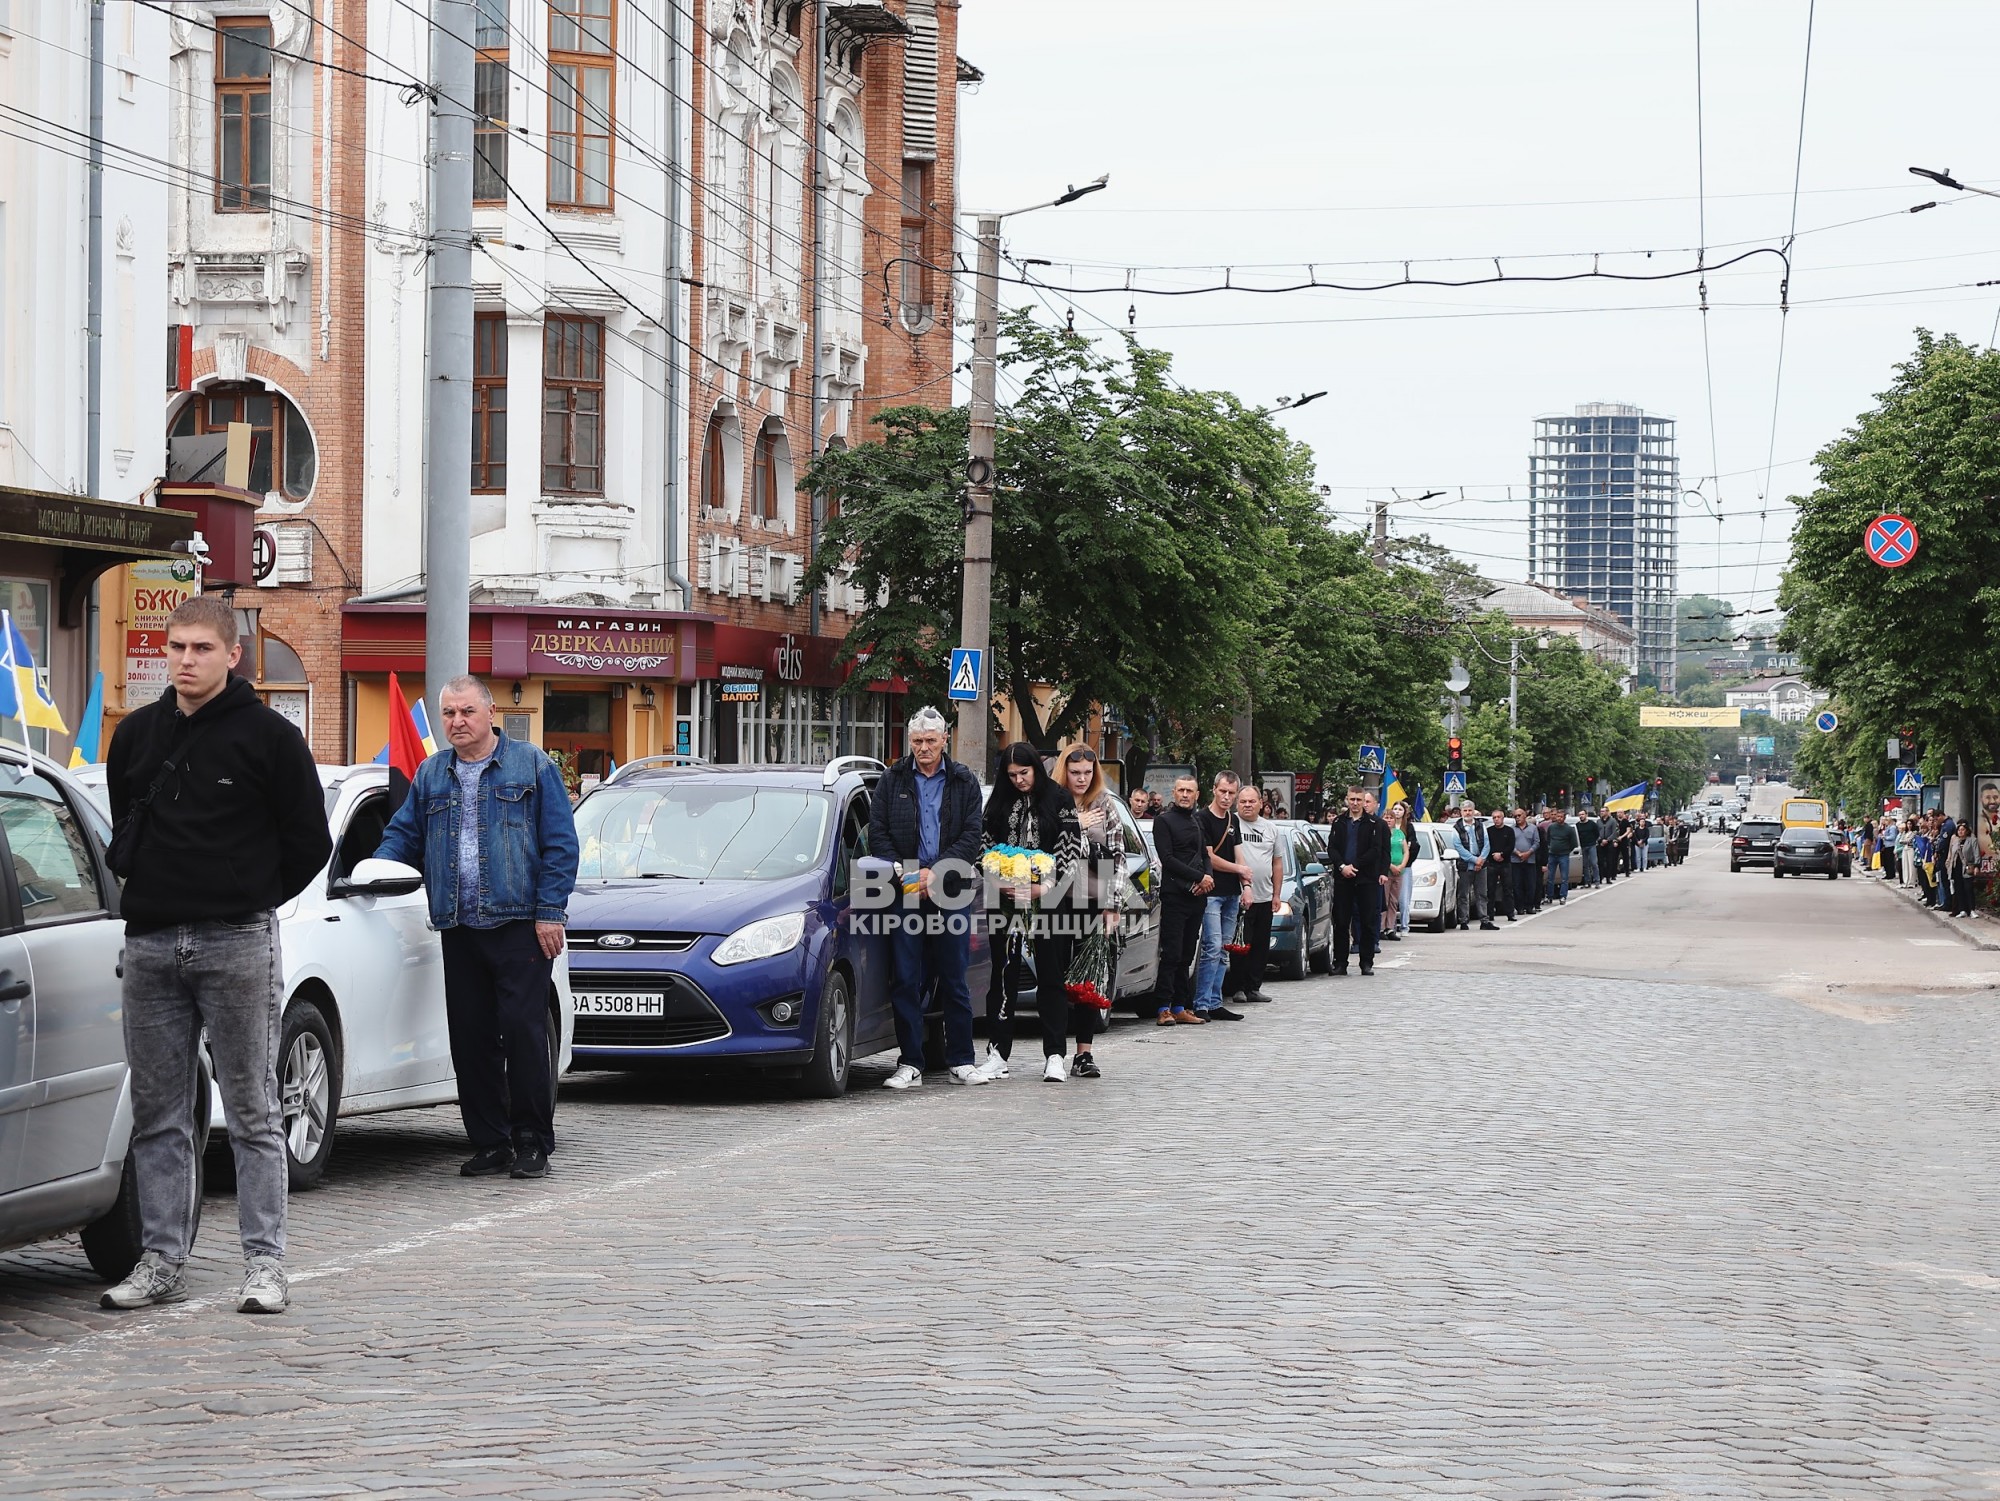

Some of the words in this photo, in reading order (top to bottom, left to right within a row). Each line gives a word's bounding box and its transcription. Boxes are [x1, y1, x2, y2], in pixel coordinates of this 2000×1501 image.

[38, 506, 80, 536] МОДНИЙ
[83, 512, 126, 540] ЖІНОЧИЙ
[557, 620, 661, 632] МАГАЗИН
[139, 633, 149, 646] 2
[530, 634, 675, 654] ДЗЕРКАЛЬНИЙ
[129, 647, 160, 656] поверх
[778, 633, 802, 680] elis
[136, 660, 167, 669] РЕМО
[723, 683, 758, 693] ОБМІН
[721, 693, 760, 702] ВАЛЮТ
[605, 935, 626, 945] Ford
[594, 996, 633, 1012] 5508
[637, 997, 661, 1013] HH
